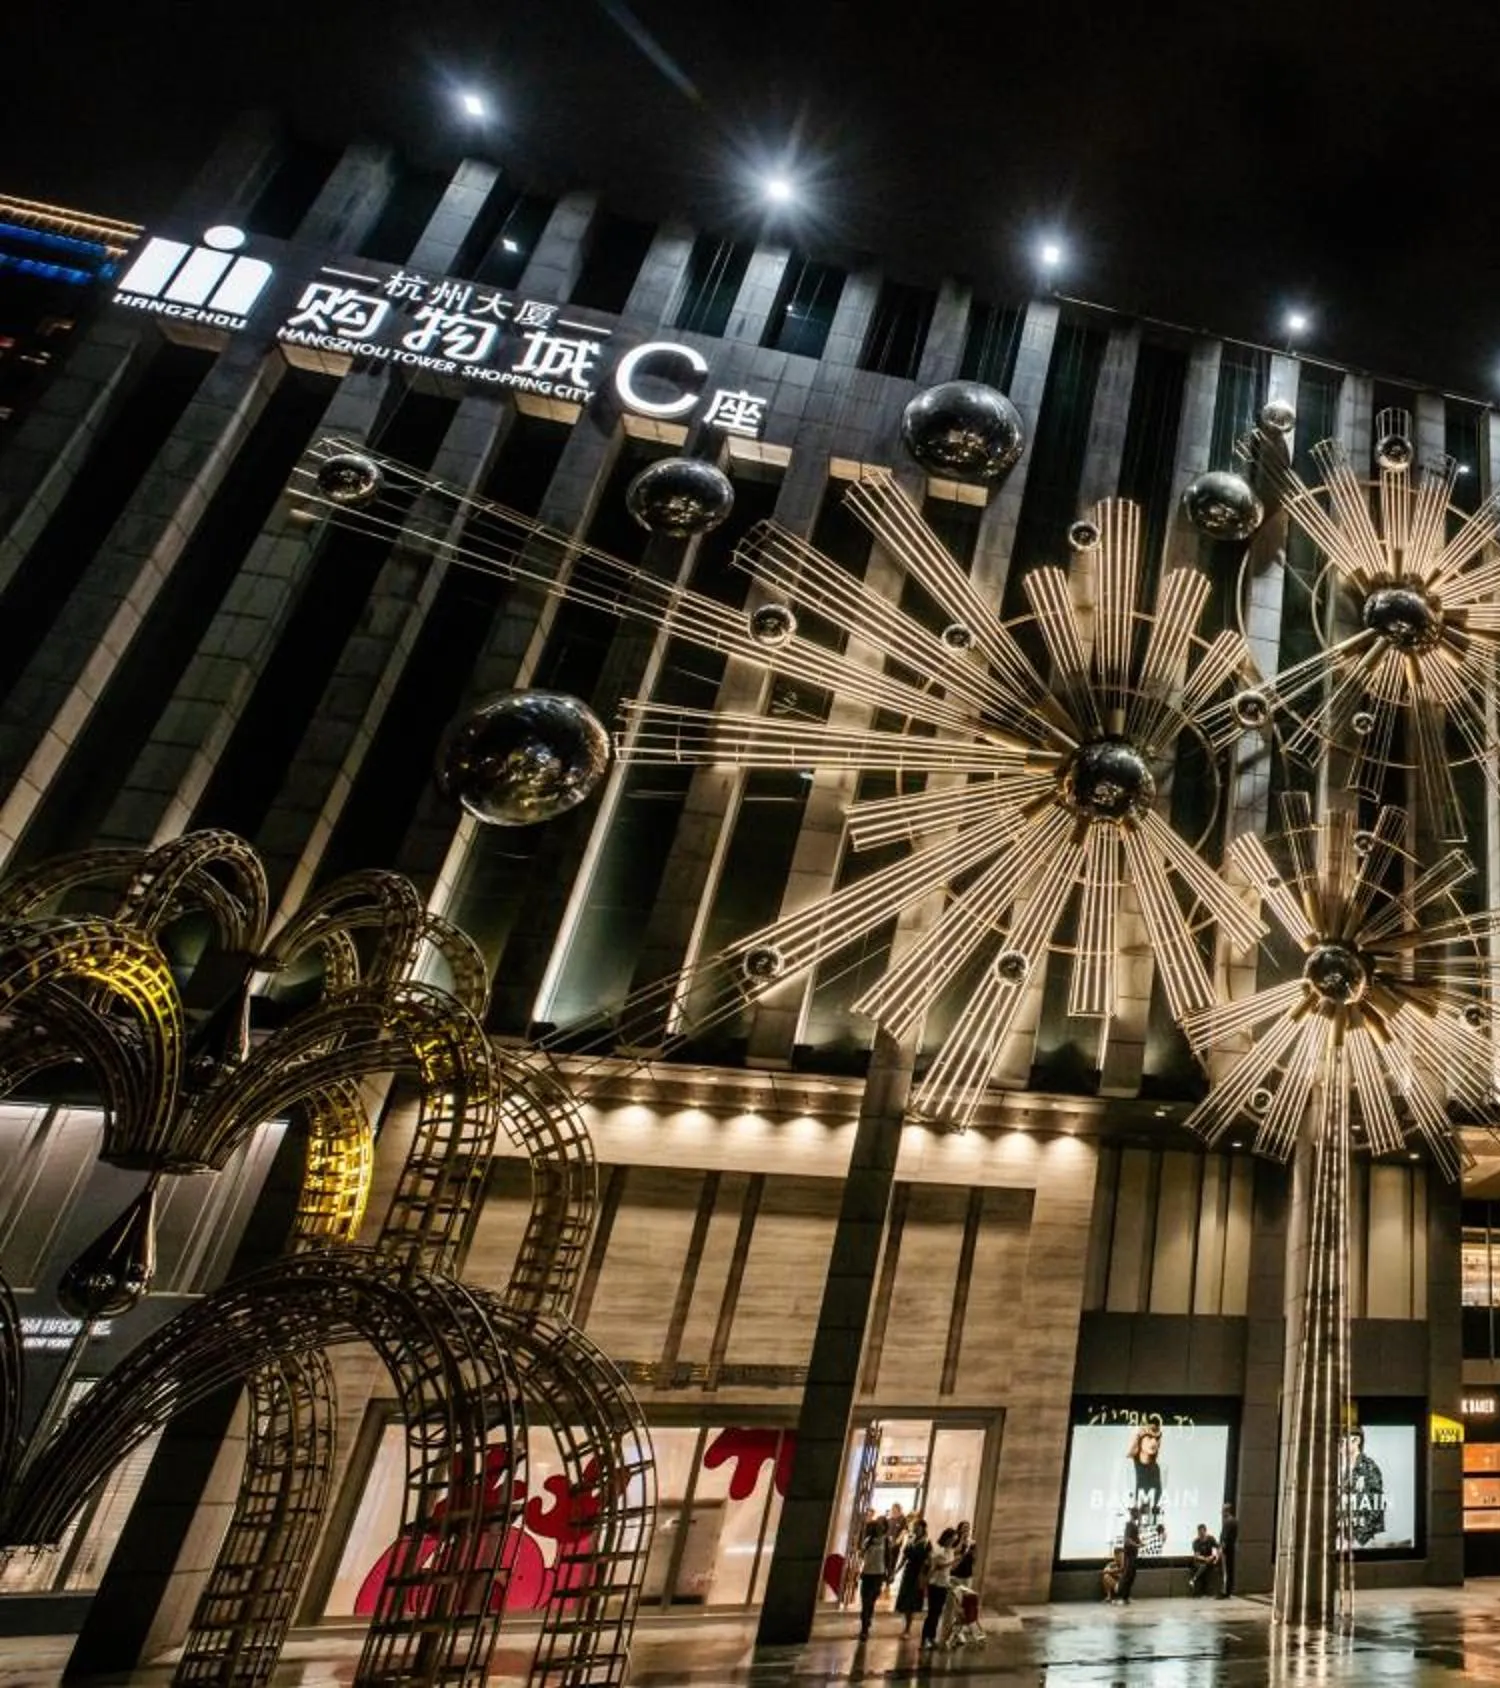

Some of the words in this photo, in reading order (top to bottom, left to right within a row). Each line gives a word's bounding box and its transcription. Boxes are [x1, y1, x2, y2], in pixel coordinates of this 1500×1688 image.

[112, 293, 247, 330] HANGZHOU
[384, 270, 560, 330] 杭州大厦
[276, 326, 390, 361] HANGZHOU
[392, 347, 456, 374] TOWER
[461, 364, 552, 396] SHOPPING
[552, 384, 595, 403] CITY
[287, 282, 602, 388] 购物城
